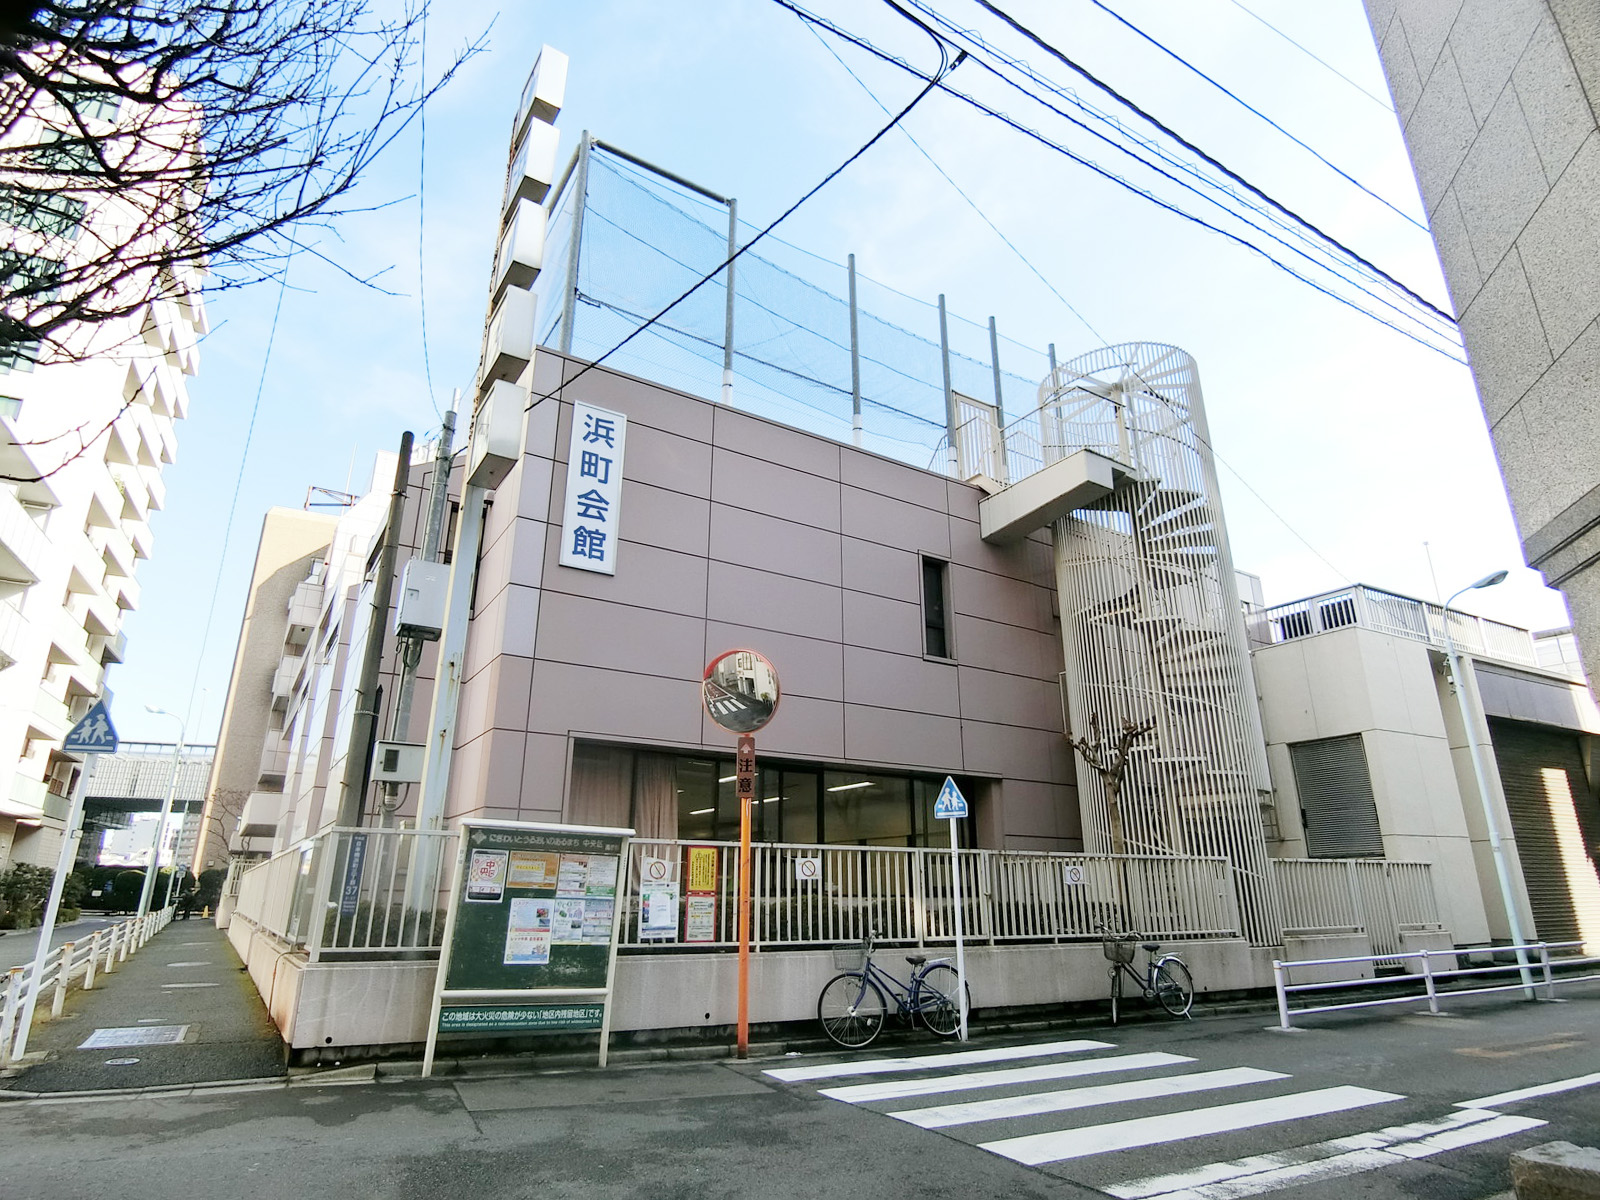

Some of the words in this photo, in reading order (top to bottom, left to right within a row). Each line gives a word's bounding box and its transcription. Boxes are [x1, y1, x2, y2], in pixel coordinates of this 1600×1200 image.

[572, 413, 615, 562] 浜町会館
[738, 757, 753, 793] 注意
[489, 833, 579, 847] にぎわいとうるおいのあるまち
[582, 839, 604, 849] 中央区
[345, 886, 358, 895] 37
